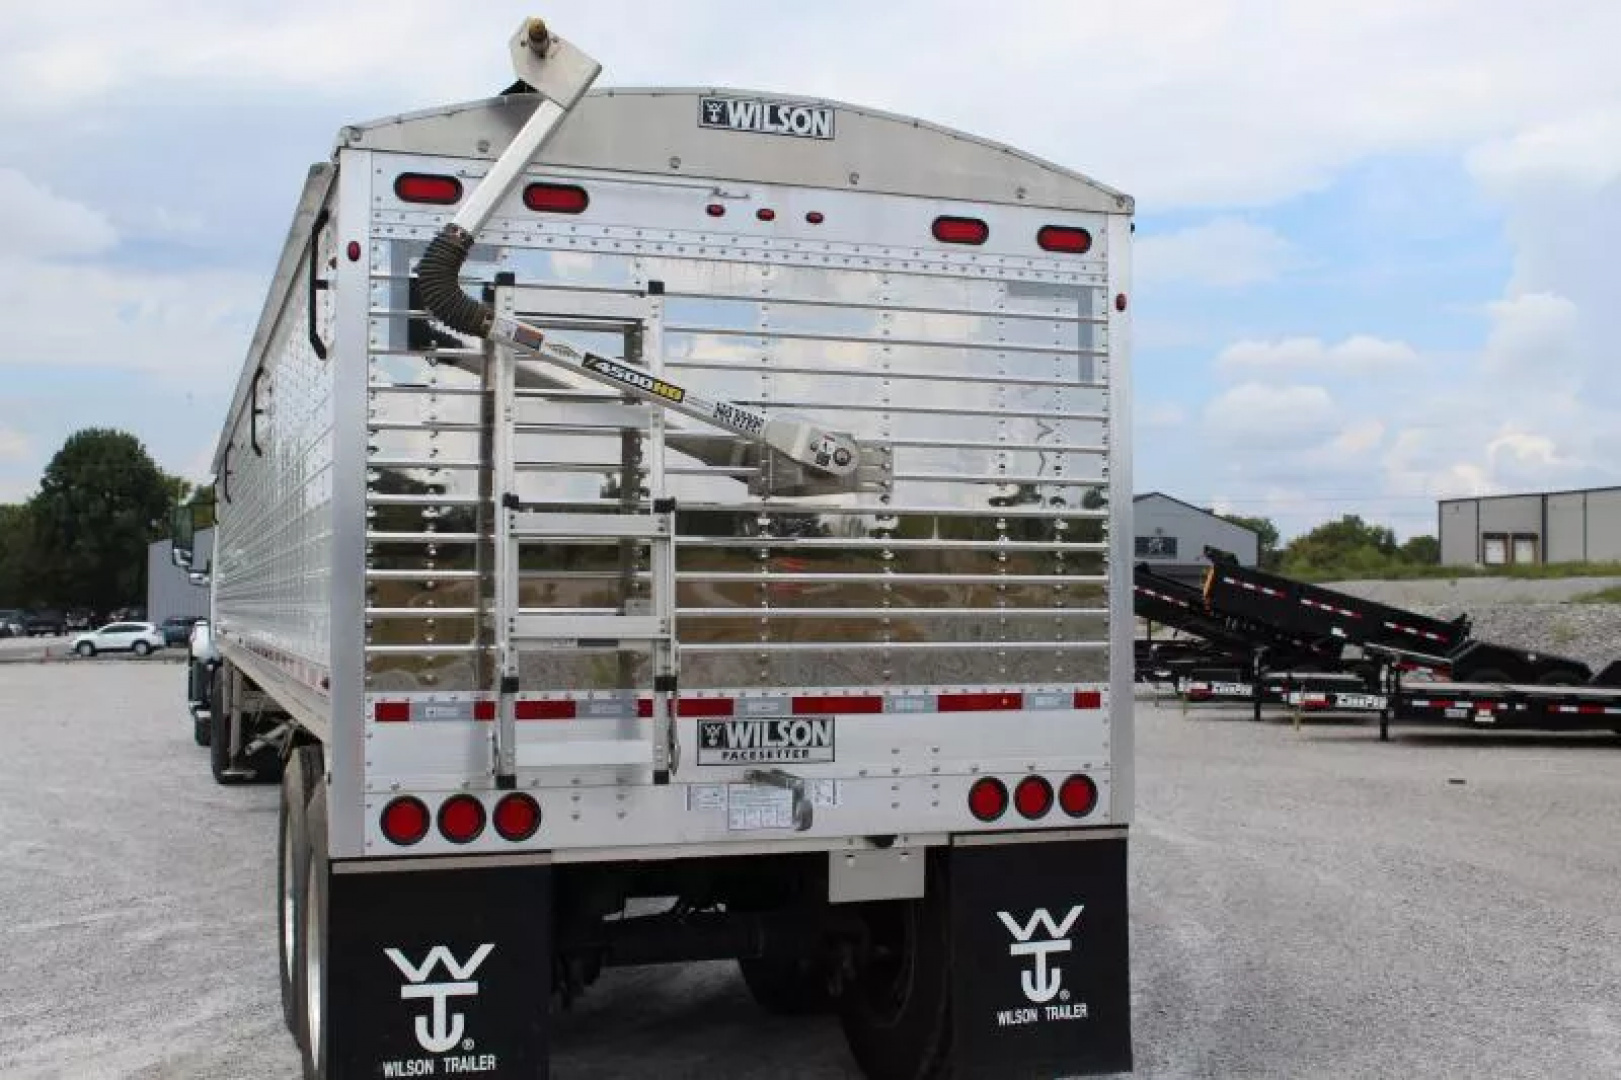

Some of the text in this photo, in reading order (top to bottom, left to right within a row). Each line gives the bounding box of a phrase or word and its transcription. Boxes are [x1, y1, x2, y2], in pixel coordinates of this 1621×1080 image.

[727, 99, 830, 138] WILSON
[727, 719, 832, 749] WILSON
[722, 749, 809, 761] PACESETTER
[997, 1003, 1087, 1026] WILSON TRAILER
[383, 1054, 496, 1079] WILSON TRAILER
